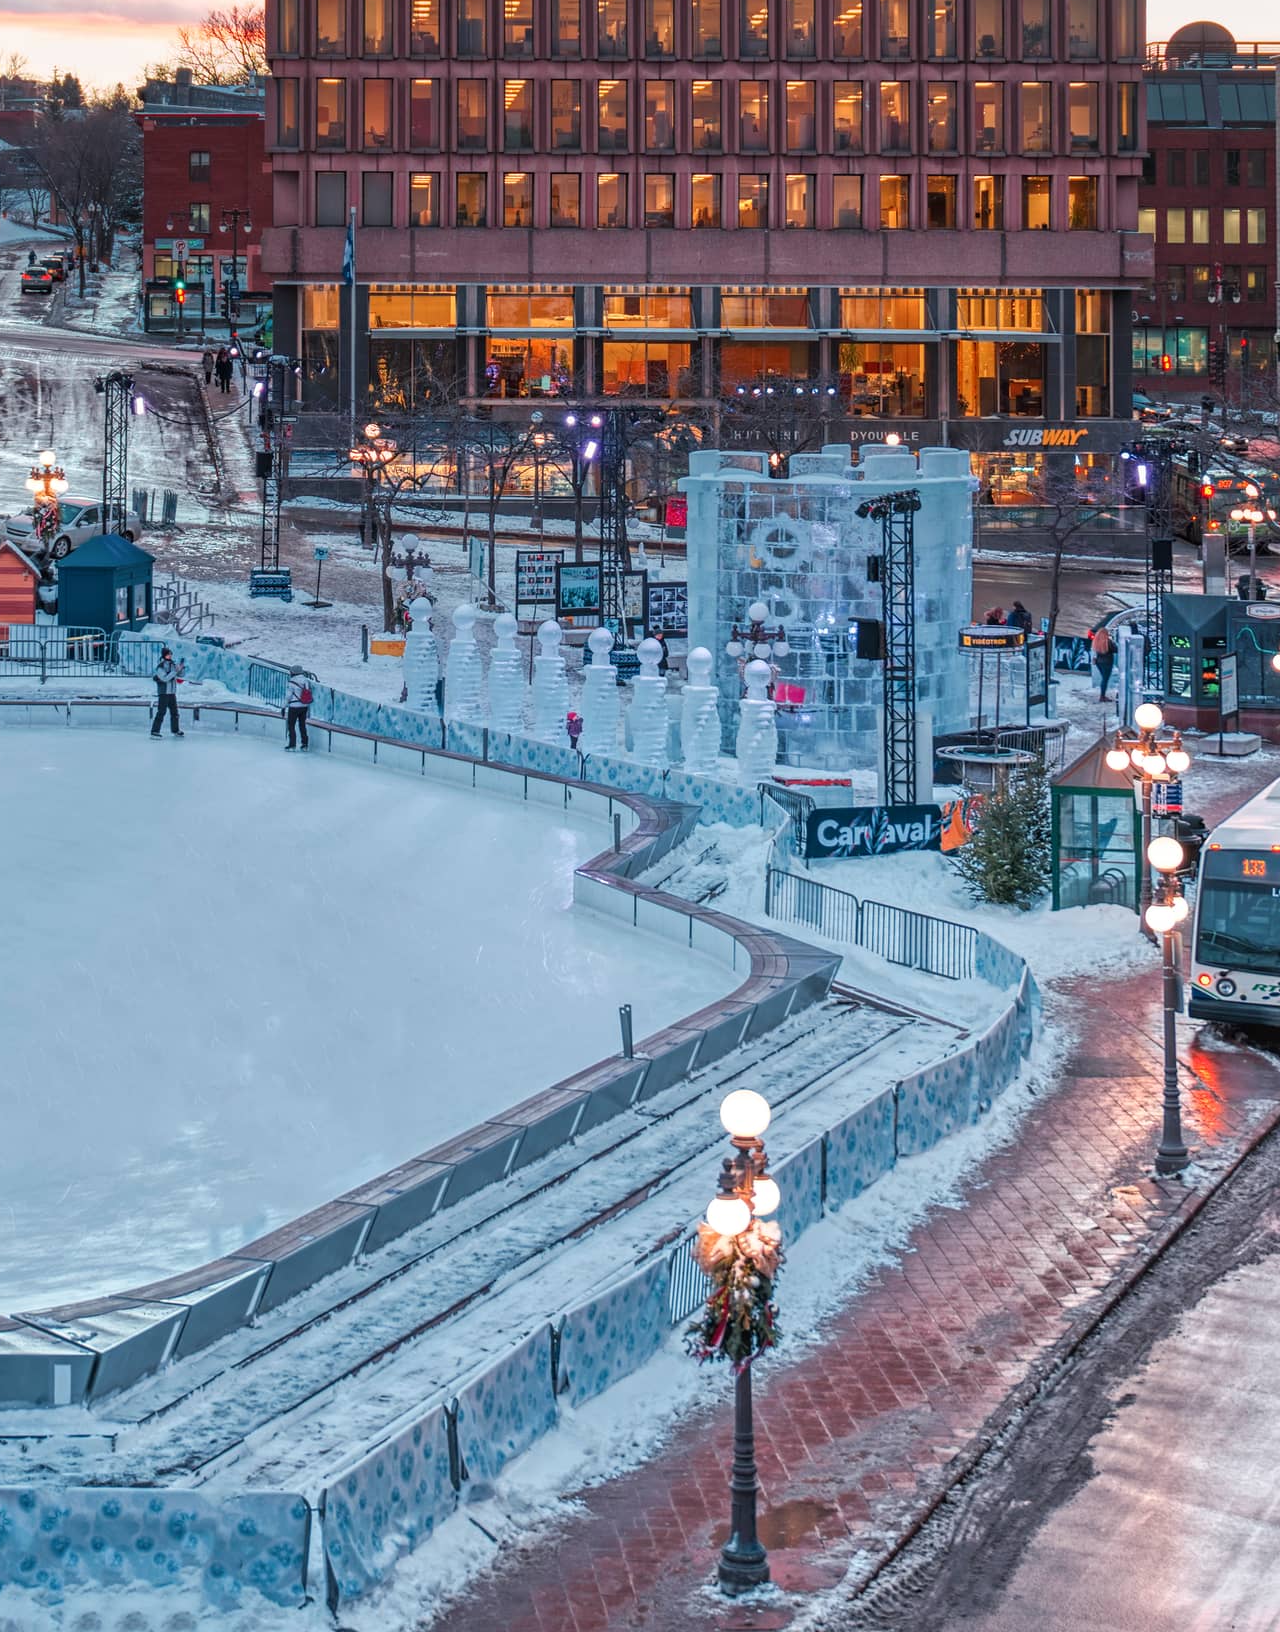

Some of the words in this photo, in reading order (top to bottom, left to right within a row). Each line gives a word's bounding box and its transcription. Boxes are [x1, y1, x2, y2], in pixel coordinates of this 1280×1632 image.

[850, 431, 920, 441] DYOULE
[1002, 428, 1089, 446] SUBWAY
[817, 814, 932, 848] Caraval
[1242, 858, 1266, 877] 133
